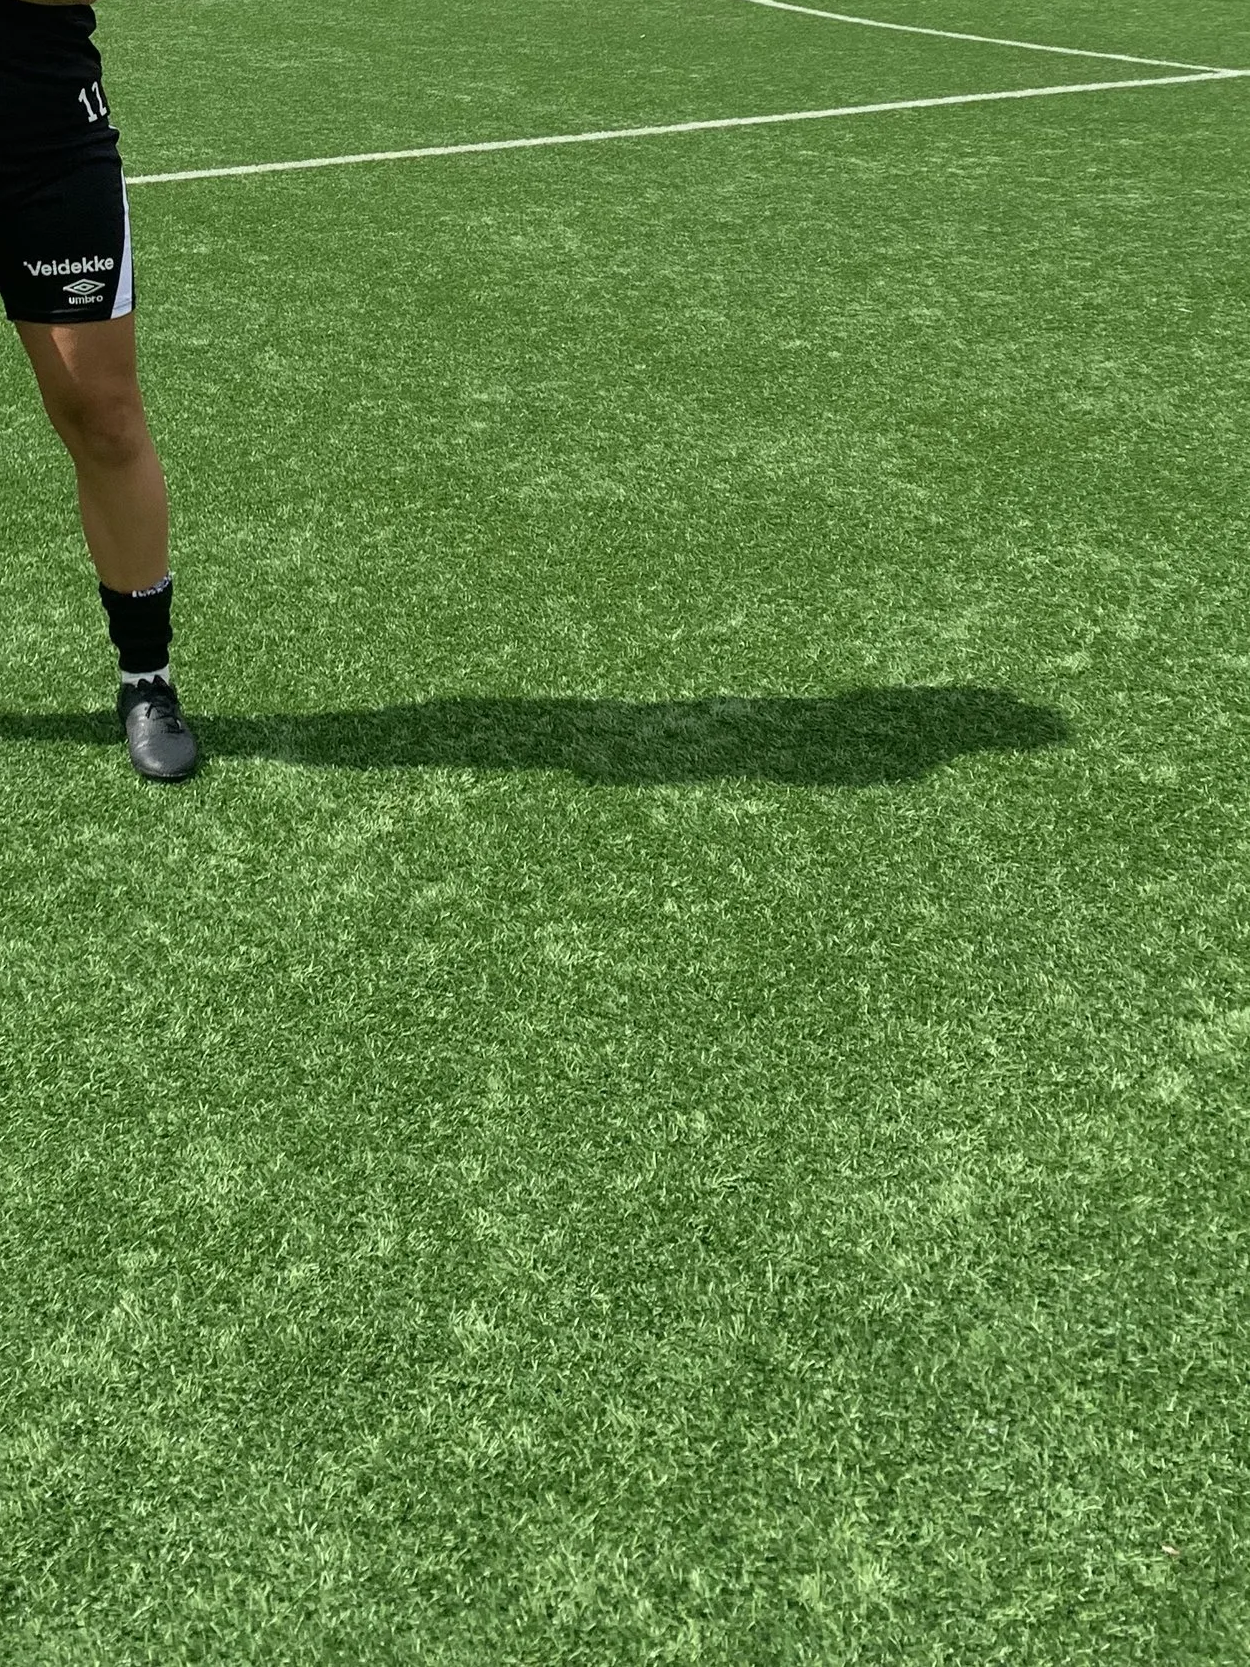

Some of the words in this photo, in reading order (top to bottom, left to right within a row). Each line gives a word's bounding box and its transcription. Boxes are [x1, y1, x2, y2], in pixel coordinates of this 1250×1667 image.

[78, 81, 108, 123] 11
[23, 255, 115, 276] Veidekke
[68, 295, 104, 305] umbro
